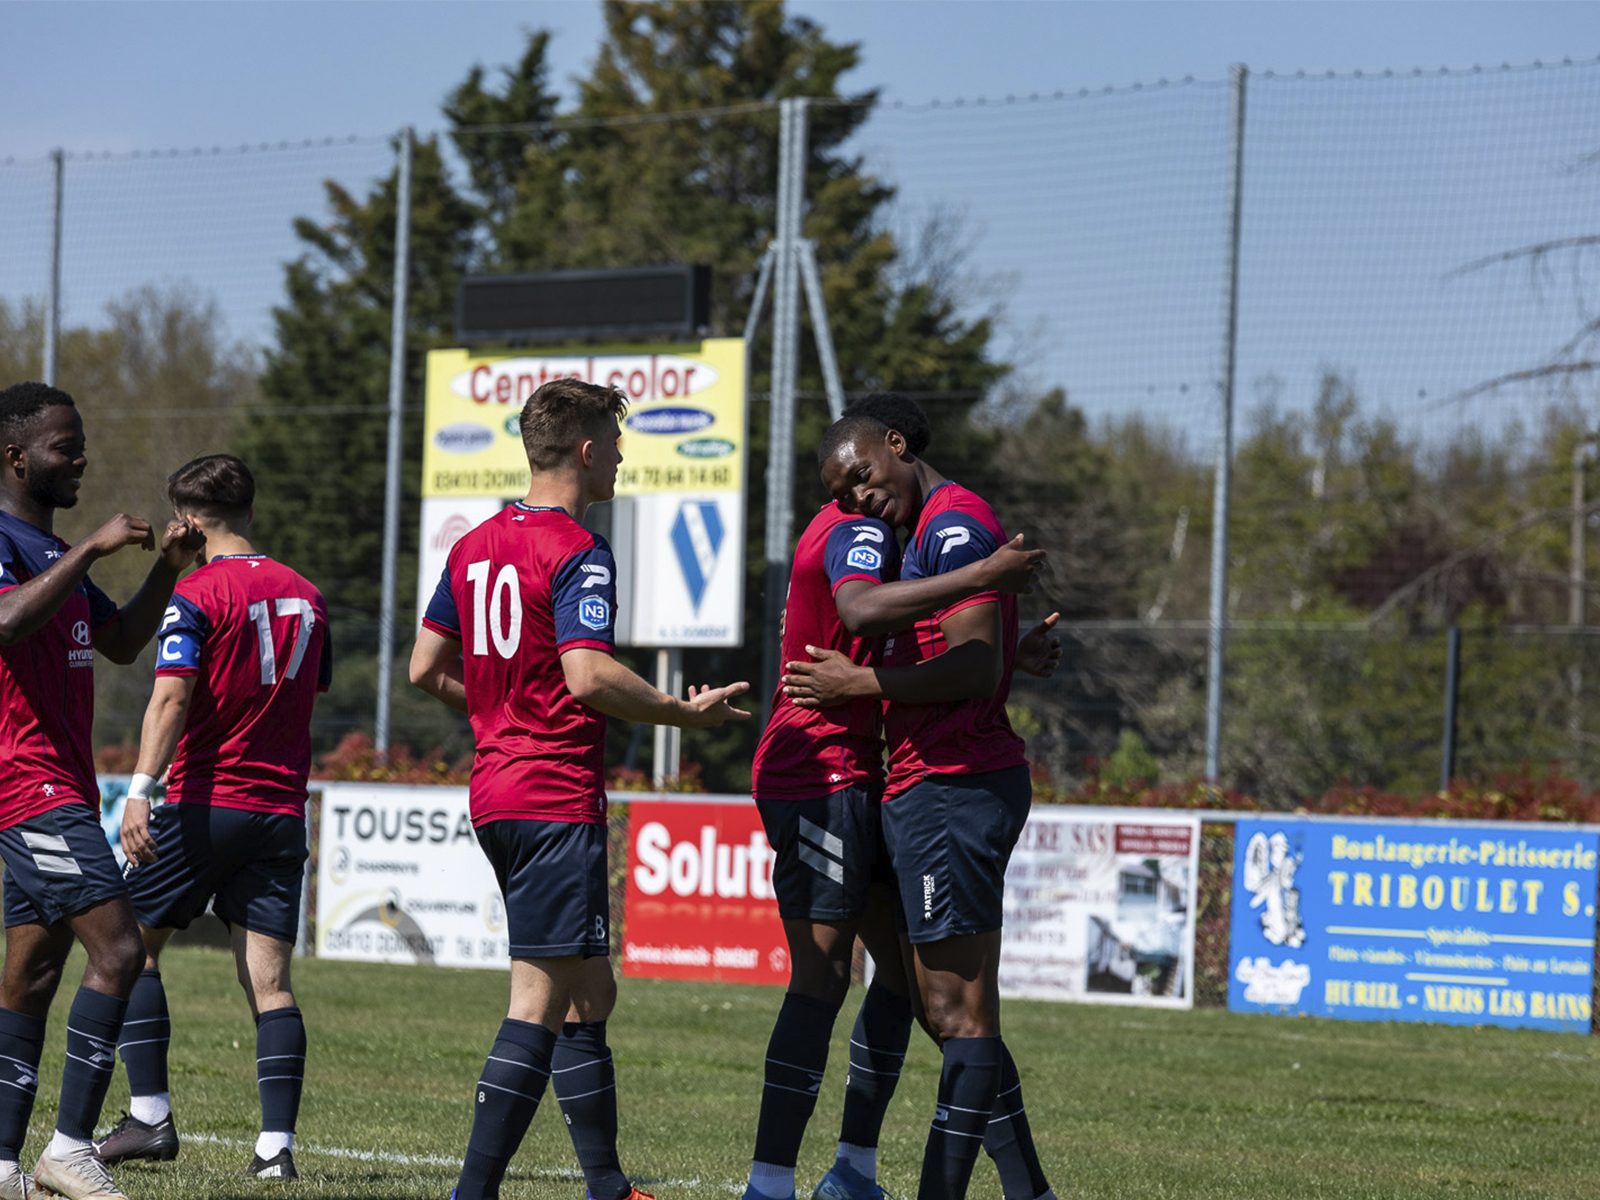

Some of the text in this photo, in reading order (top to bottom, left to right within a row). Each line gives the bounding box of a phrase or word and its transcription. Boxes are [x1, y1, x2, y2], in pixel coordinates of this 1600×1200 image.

[607, 354, 696, 400] color
[854, 552, 875, 564] N3
[466, 559, 522, 659] 10
[585, 604, 605, 619] N3
[162, 634, 183, 661] C
[248, 597, 314, 684] 17
[633, 821, 777, 899] Solut
[1331, 834, 1597, 870] Boulangerie-Pâtisserie
[923, 874, 932, 910] PATRICK
[1328, 871, 1544, 914] TRIBOULET
[1488, 988, 1526, 1017] LES
[1530, 991, 1592, 1022] BAINS
[478, 1091, 486, 1103] 8
